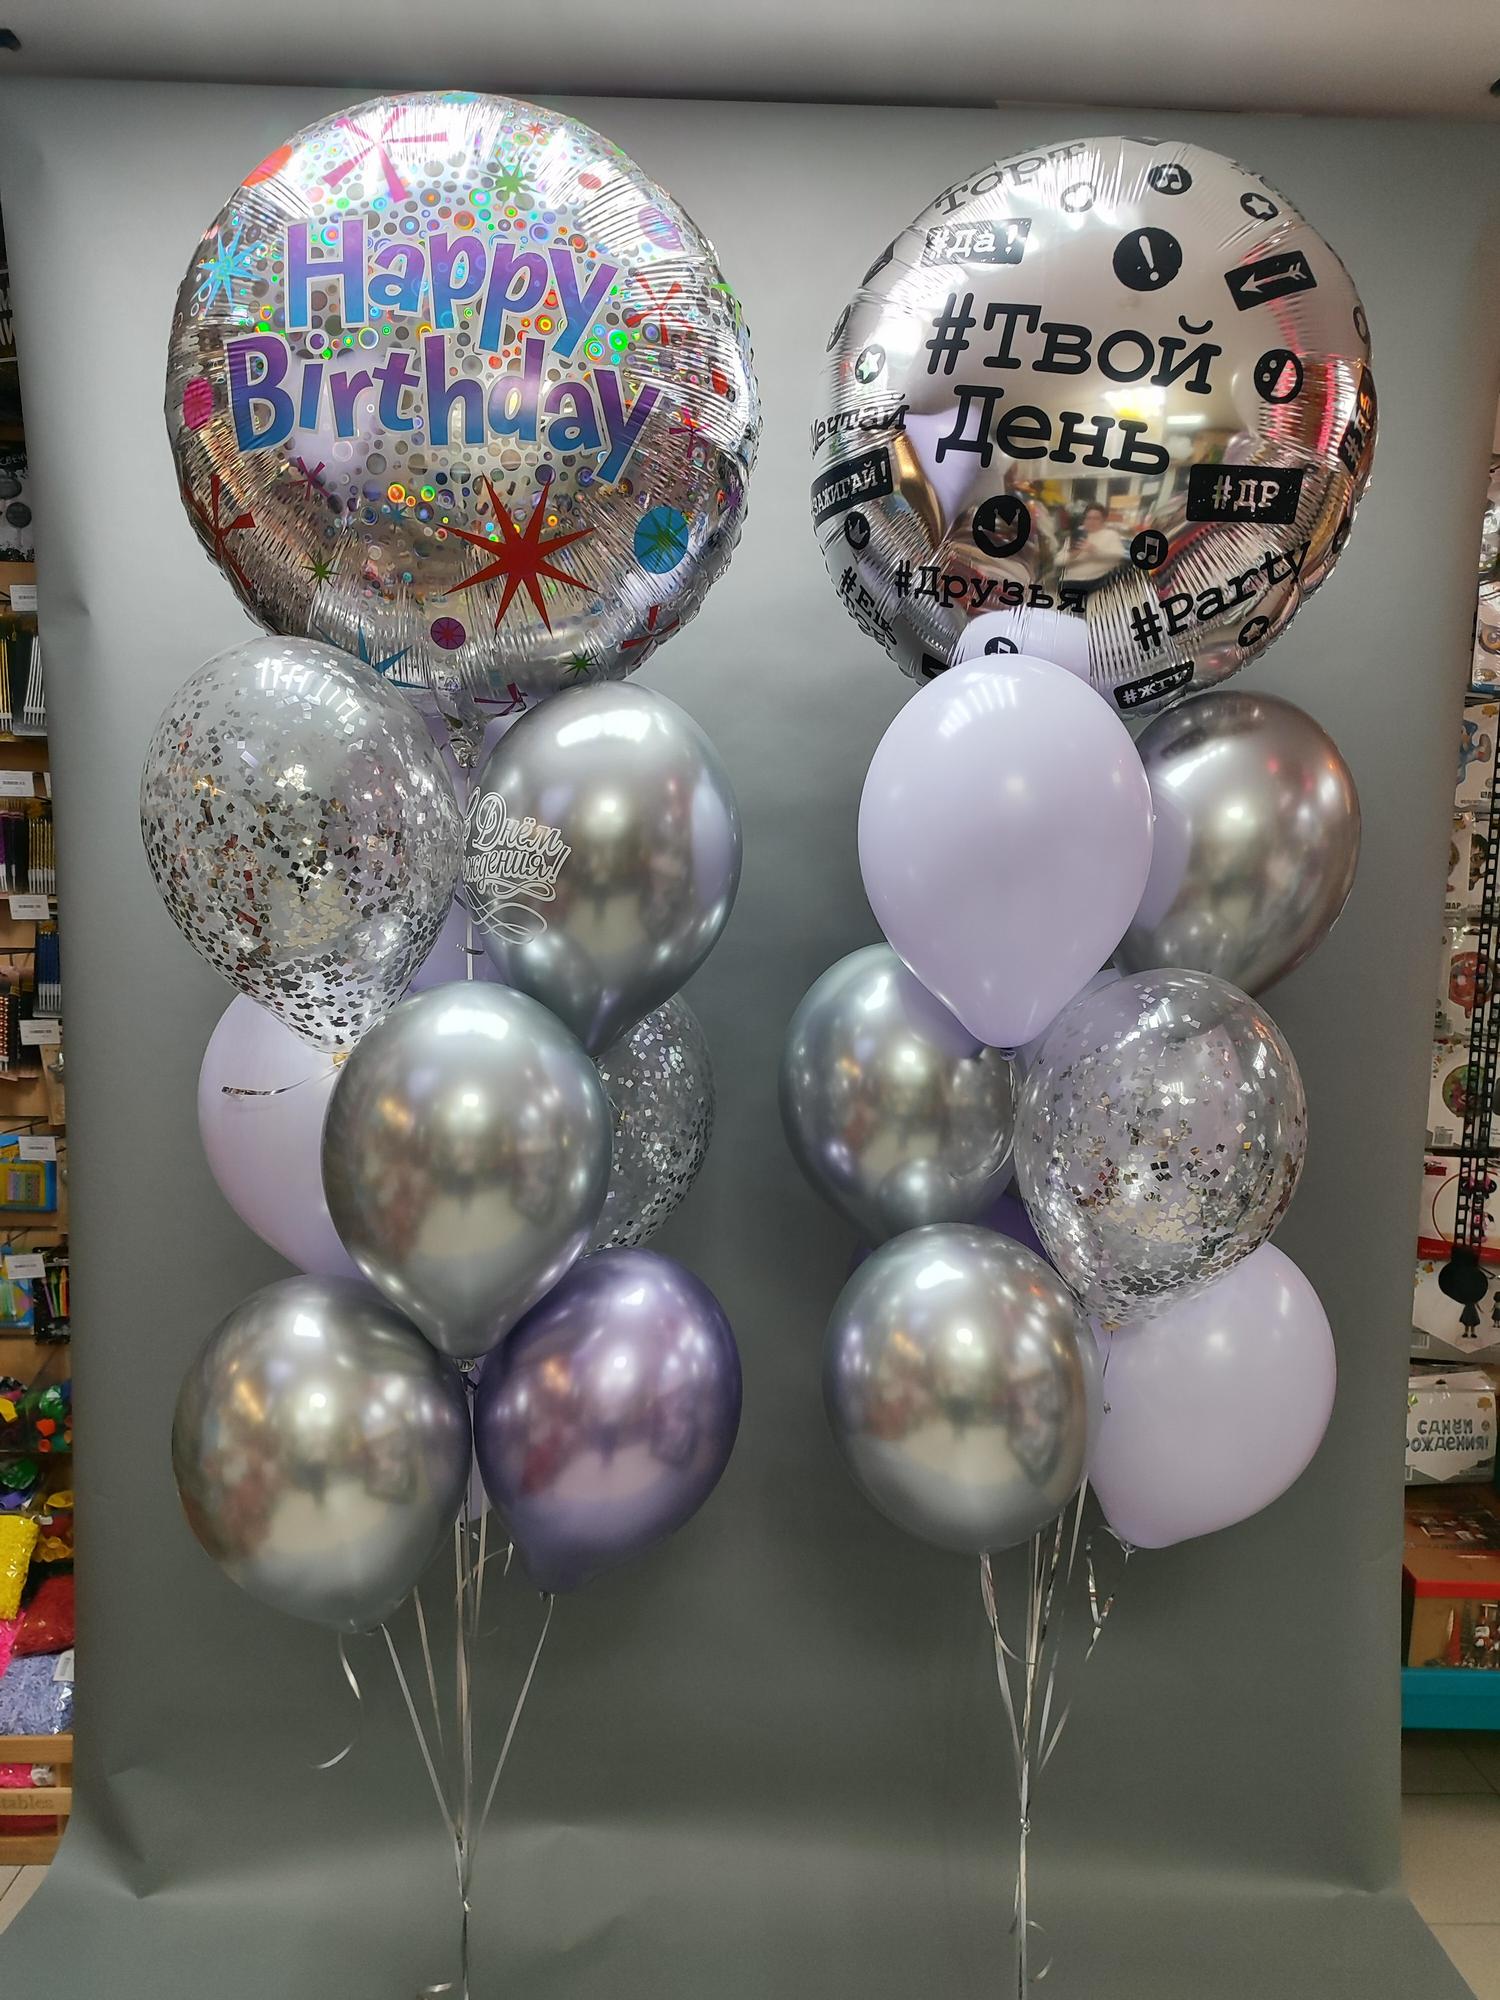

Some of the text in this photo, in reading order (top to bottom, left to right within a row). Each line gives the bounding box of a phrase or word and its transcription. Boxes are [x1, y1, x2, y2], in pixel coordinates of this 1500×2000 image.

[285, 217, 619, 358] Happy
[925, 293, 1222, 395] #Твой
[225, 332, 662, 484] Birthday
[935, 385, 1170, 476] День
[894, 559, 1089, 613] #Друзья
[1130, 540, 1312, 651] #Party
